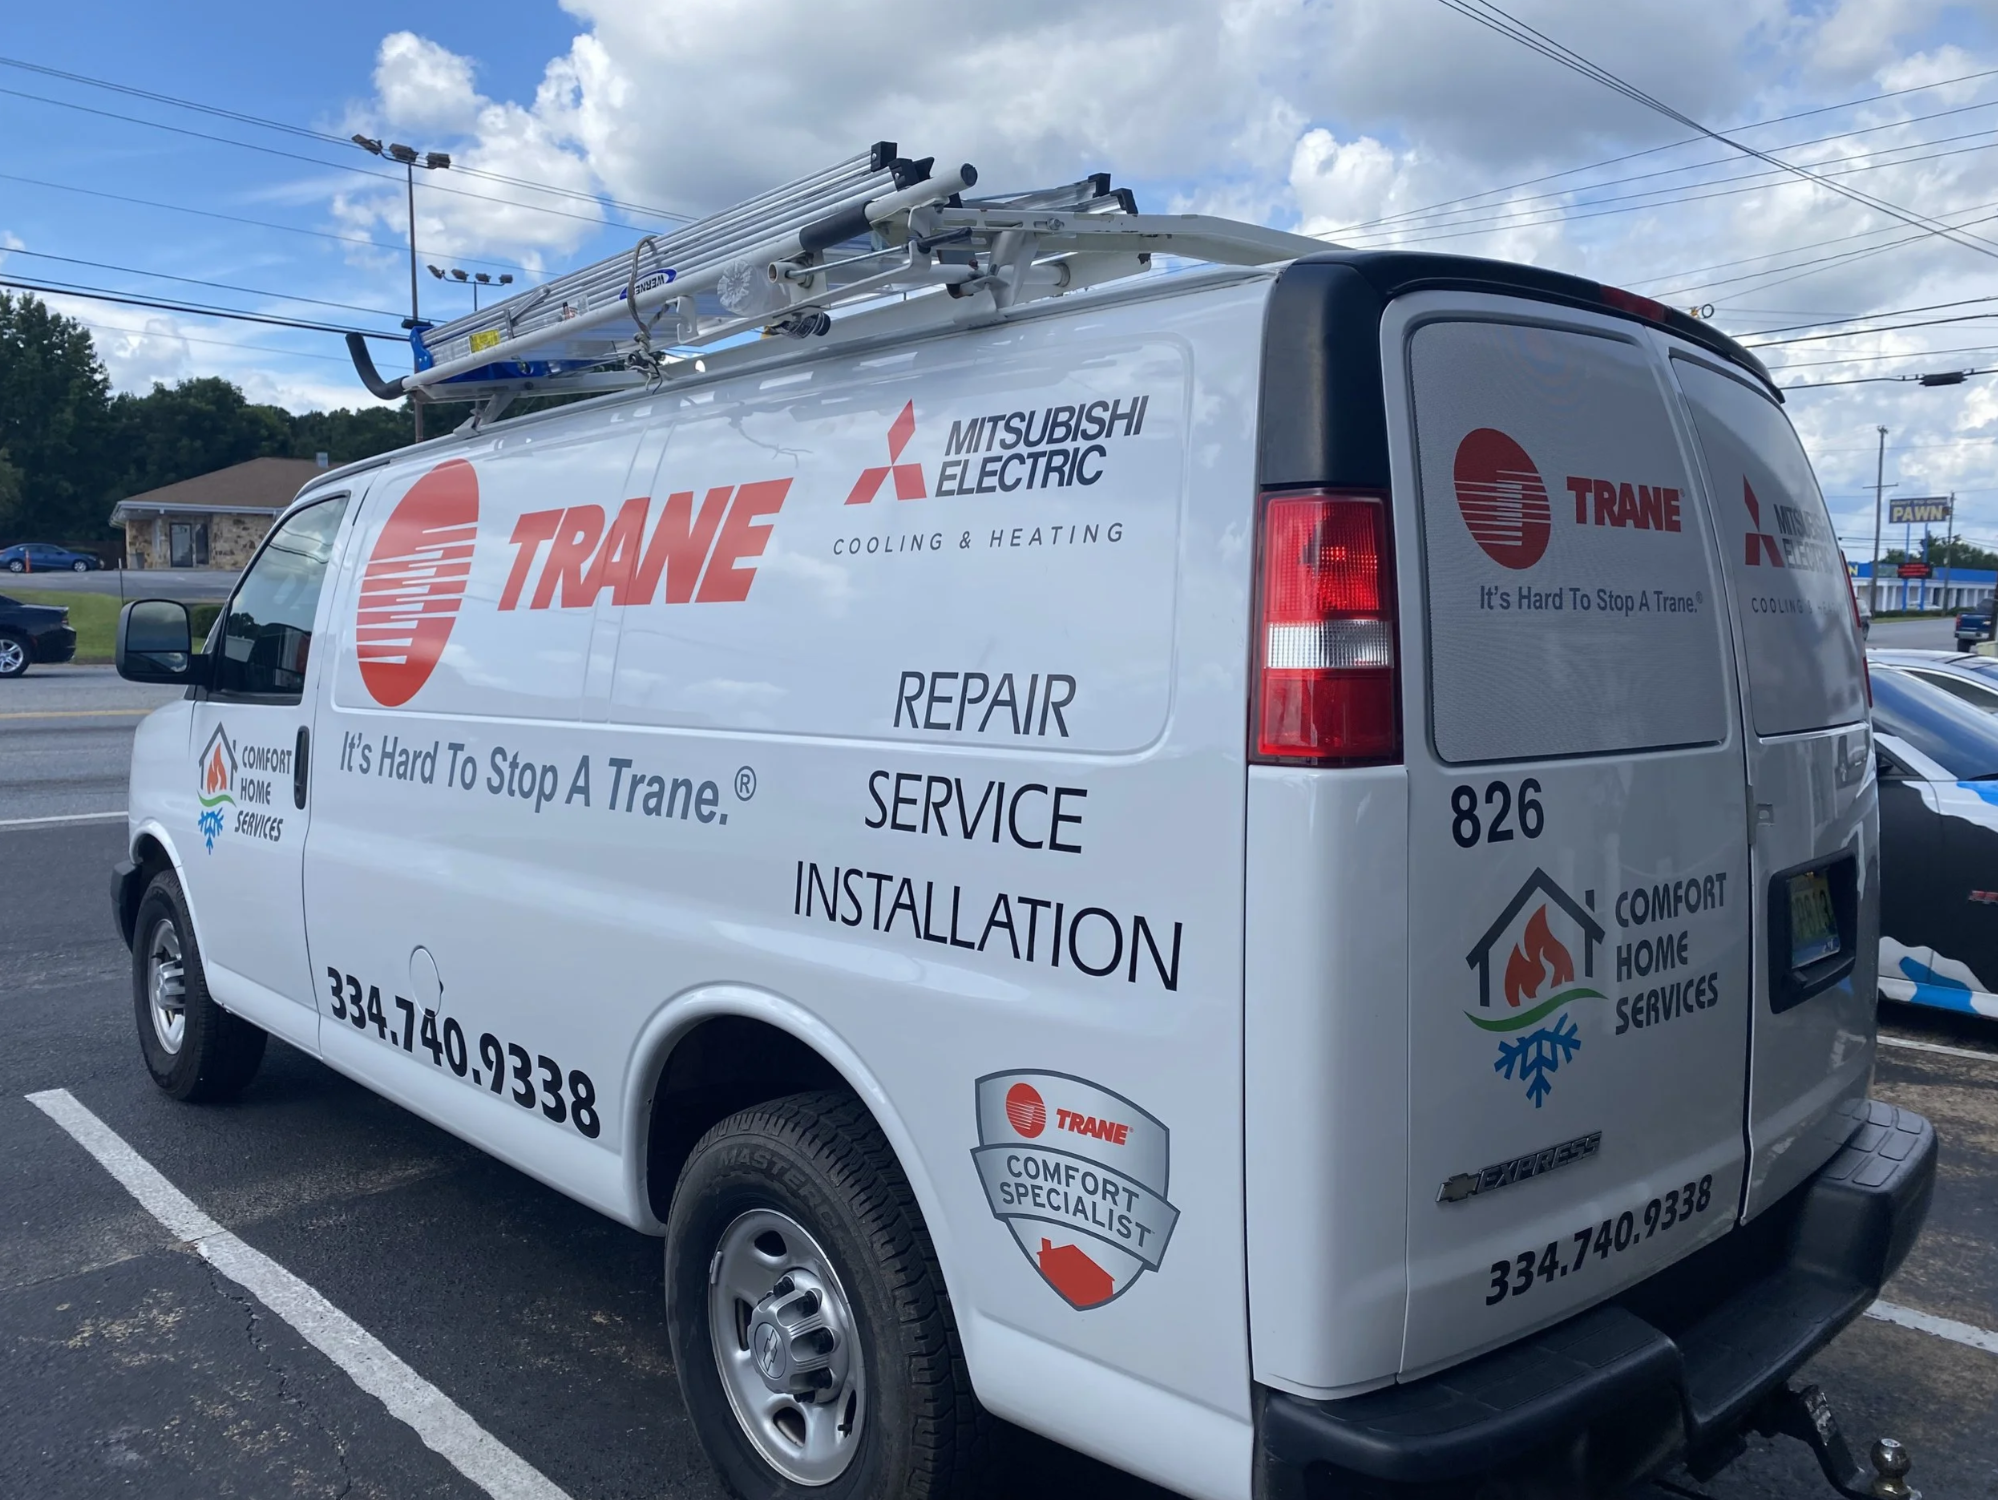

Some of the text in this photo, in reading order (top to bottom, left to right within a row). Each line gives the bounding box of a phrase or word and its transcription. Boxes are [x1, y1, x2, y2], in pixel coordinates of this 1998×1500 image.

[634, 274, 665, 295] WERNE
[945, 395, 1150, 456] MITSUBISHI
[934, 444, 1108, 498] ELECTRIC
[833, 523, 1124, 555] COOLING & HEATING
[1893, 505, 1943, 522] PAWN
[498, 477, 794, 611] TRANE
[1480, 585, 1511, 610] It's
[1518, 586, 1563, 610] Hard
[1569, 587, 1591, 611] To
[1597, 588, 1634, 617] Stop
[1639, 590, 1650, 612] A
[1751, 598, 1804, 614] COOLING
[893, 671, 1077, 737] REPAIR
[242, 745, 292, 774] COMFORT
[340, 731, 372, 774] It's
[378, 735, 438, 784] Hard
[447, 743, 477, 790] To
[486, 746, 558, 813] Stop
[565, 755, 591, 807] A
[240, 777, 271, 805] HOME
[864, 770, 1088, 854] SERVICE
[1450, 778, 1544, 849] 826
[234, 810, 284, 842] SERVICES
[794, 860, 1184, 992] INSTALLATION
[1615, 872, 1727, 928] COMFORT
[1616, 930, 1688, 982] HOME
[1615, 971, 1718, 1036] SERVICES
[327, 966, 601, 1139] 334.740.9338
[1006, 1155, 1139, 1213] COMFORT
[1477, 1131, 1602, 1194] EXPRESS
[1000, 1181, 1151, 1247] SPECIALIST
[1485, 1174, 1712, 1306] 334.740.9338
